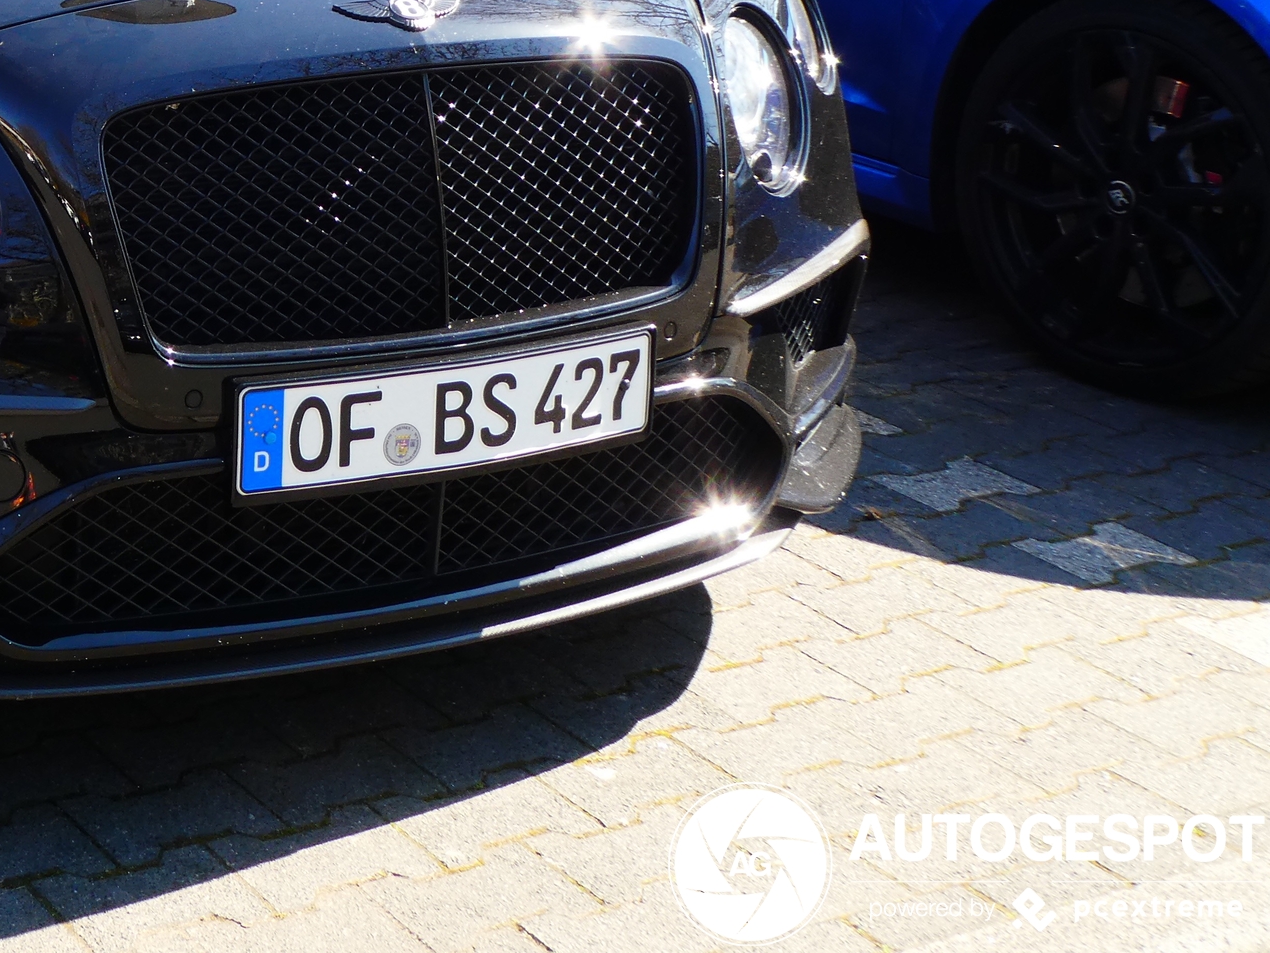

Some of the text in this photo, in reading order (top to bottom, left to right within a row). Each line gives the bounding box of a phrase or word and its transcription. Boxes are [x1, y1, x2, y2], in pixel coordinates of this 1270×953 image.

[289, 348, 641, 473] OF BS 427
[253, 450, 270, 473] D
